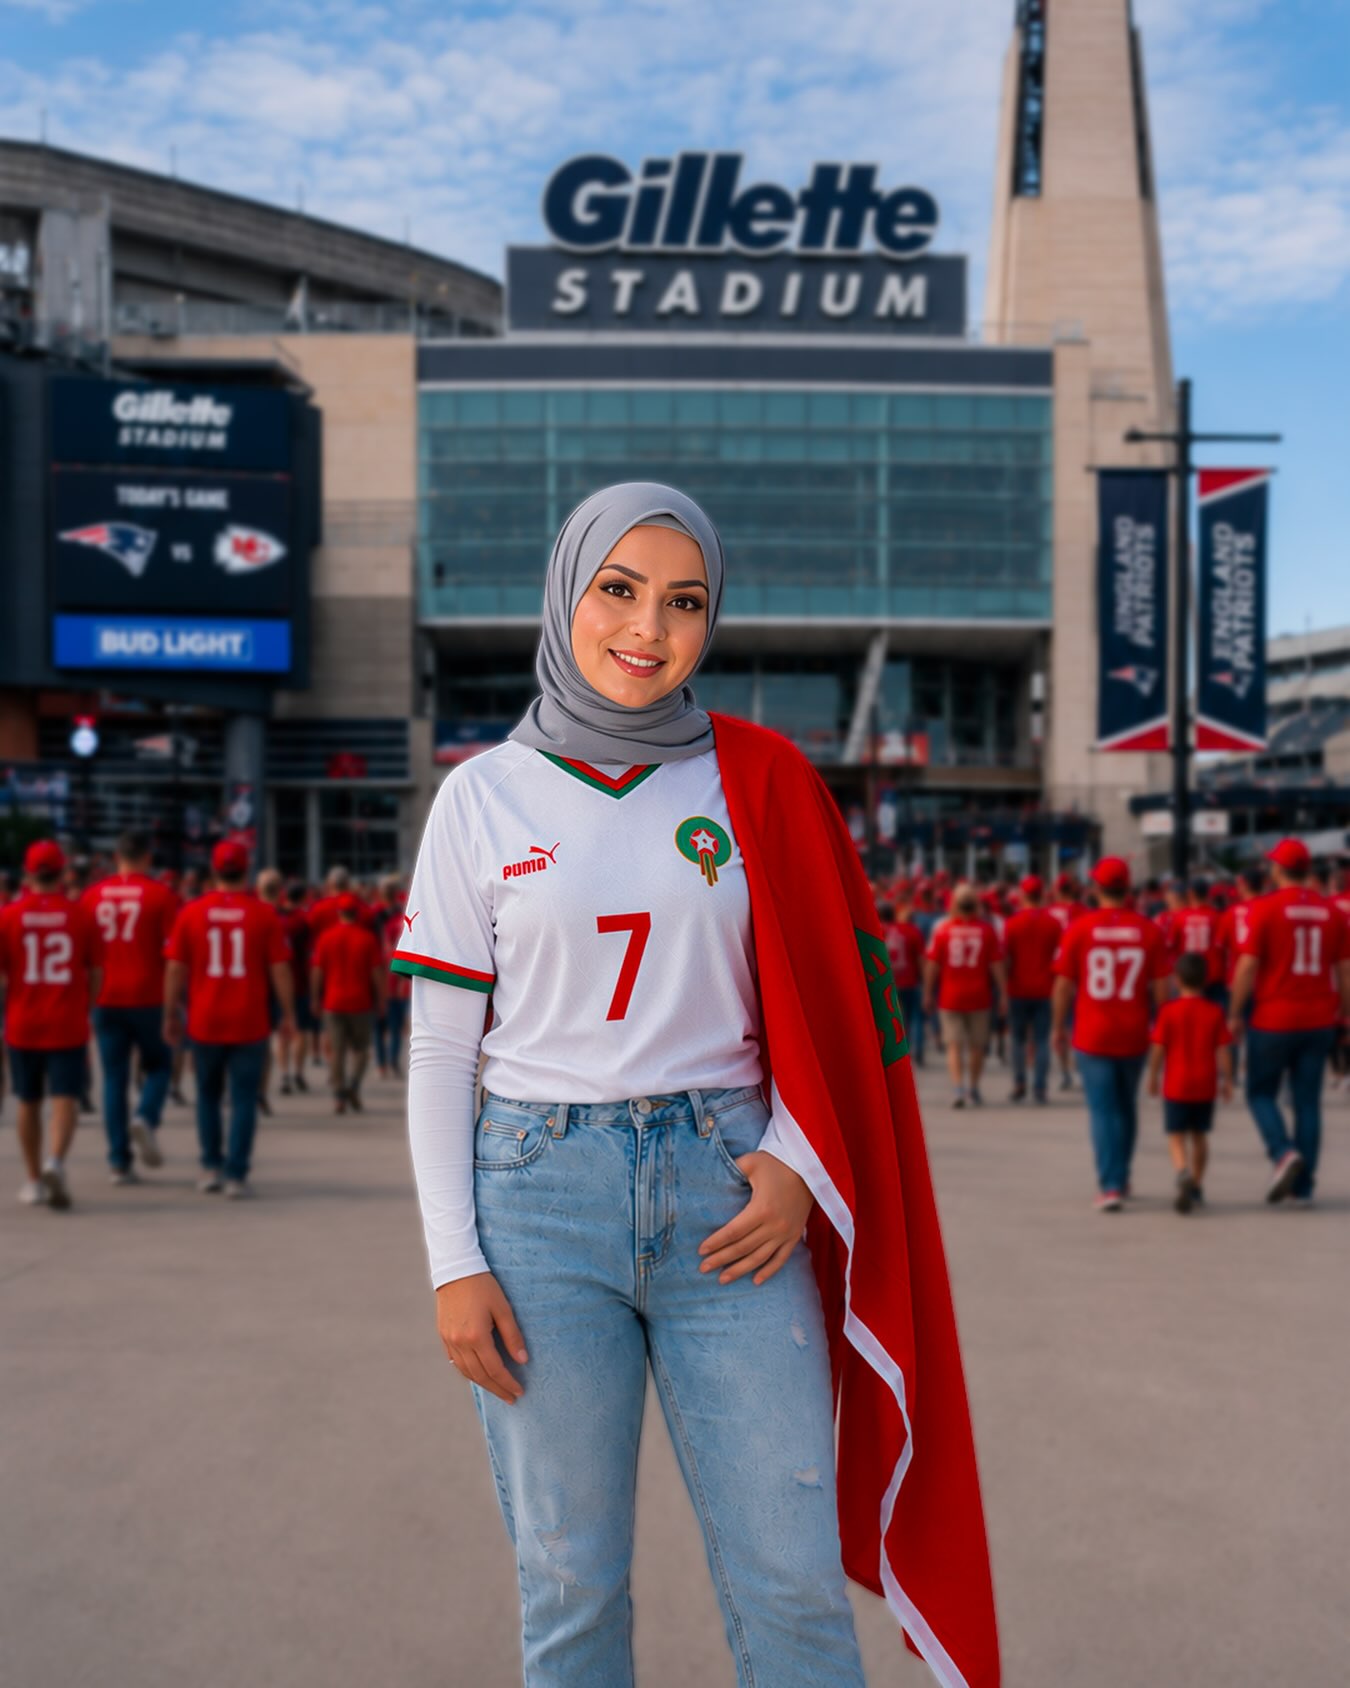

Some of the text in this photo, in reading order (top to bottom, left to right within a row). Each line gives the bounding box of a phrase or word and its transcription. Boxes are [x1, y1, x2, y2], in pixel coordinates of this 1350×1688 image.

[543, 152, 939, 258] Gillette
[552, 270, 928, 317] STADIUM
[113, 391, 232, 427] Gillette
[118, 428, 227, 449] STADIUM
[184, 488, 229, 510] GAME
[1131, 524, 1155, 648] PATRIOTS
[1231, 533, 1256, 671] PATRIOTS
[100, 629, 246, 657] BUD LIGHT
[503, 856, 547, 881] PUMA
[23, 932, 72, 984] 12
[207, 928, 247, 979] 11
[596, 911, 652, 1022] 7
[1086, 946, 1145, 1001] 87
[1292, 926, 1322, 975] 11
